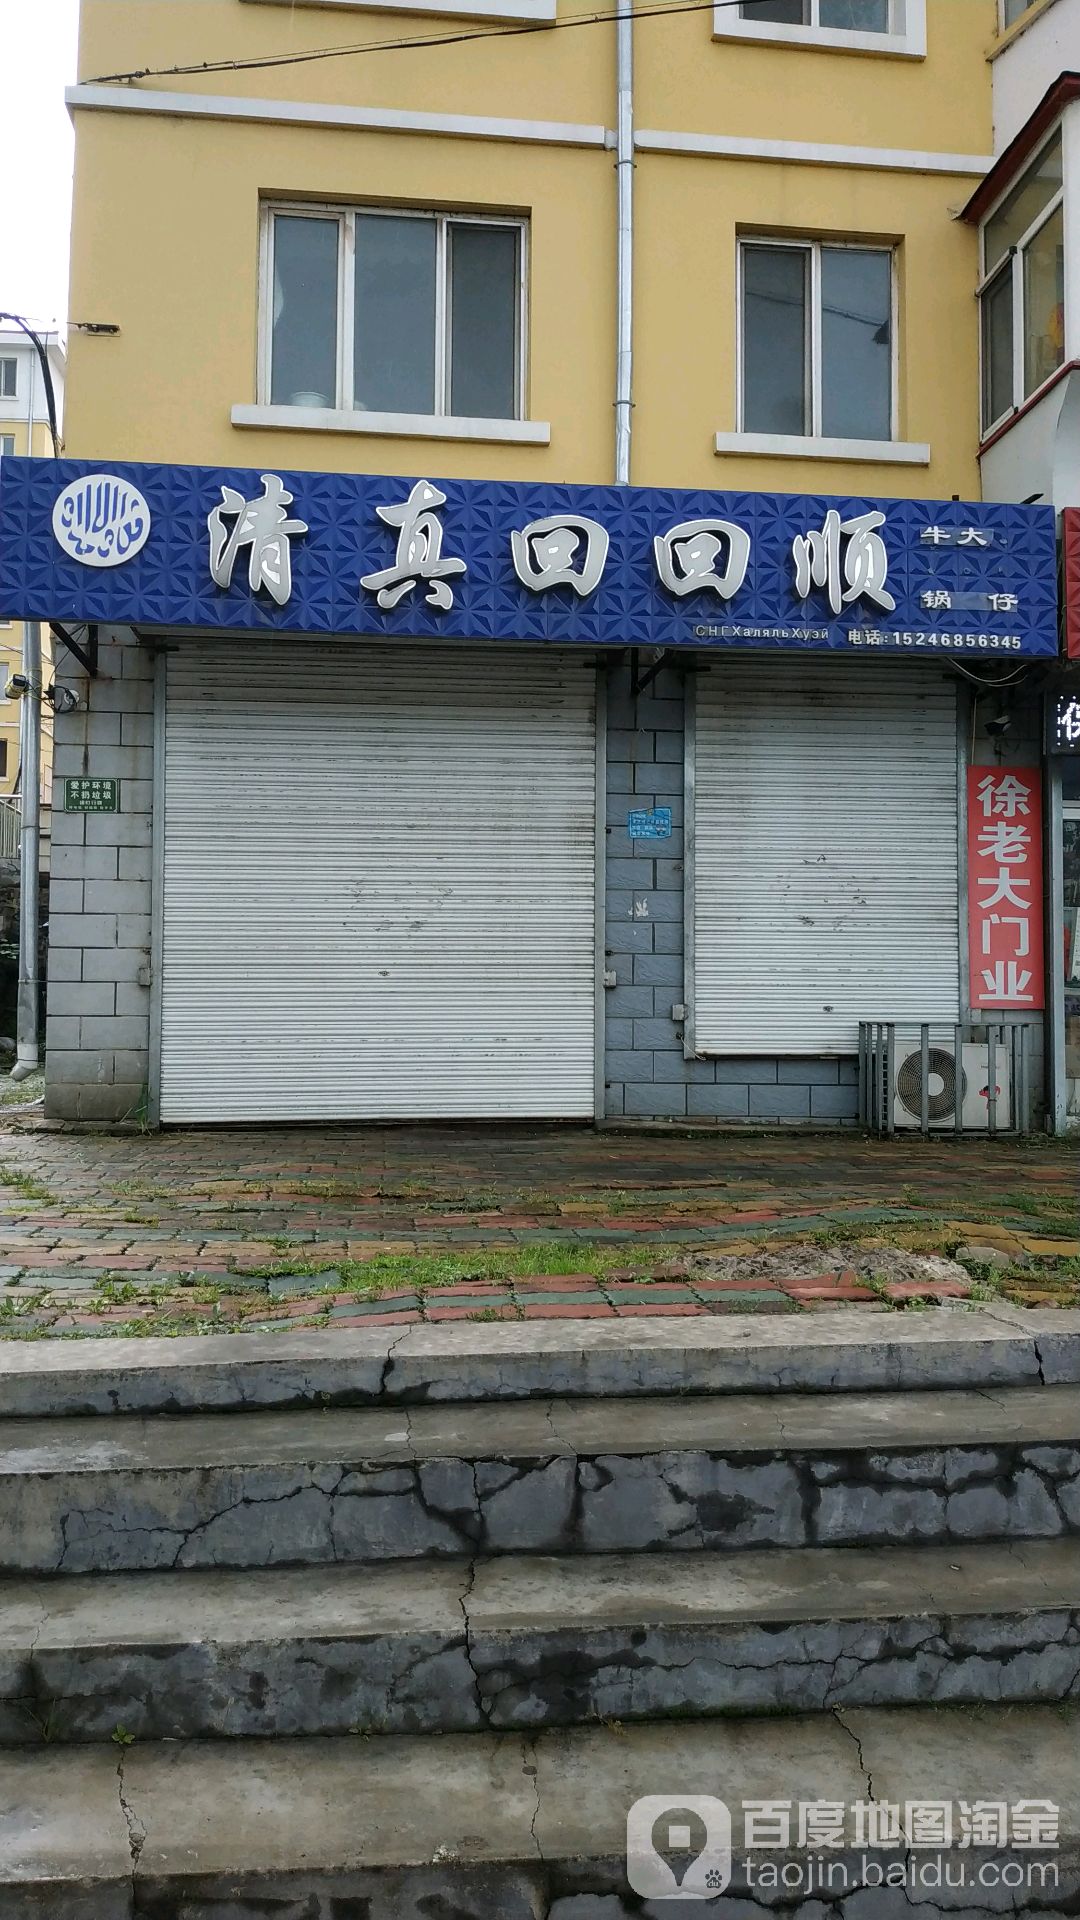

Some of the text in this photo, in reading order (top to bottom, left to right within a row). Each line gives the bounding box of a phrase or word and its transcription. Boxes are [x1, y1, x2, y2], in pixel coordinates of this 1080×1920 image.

[207, 473, 897, 615] 清真回回顺
[920, 526, 988, 546] 牛大
[70, 781, 112, 790] 爱护环境
[70, 791, 112, 800] 不扔垃圾
[976, 773, 1034, 1002] 徐老大门业
